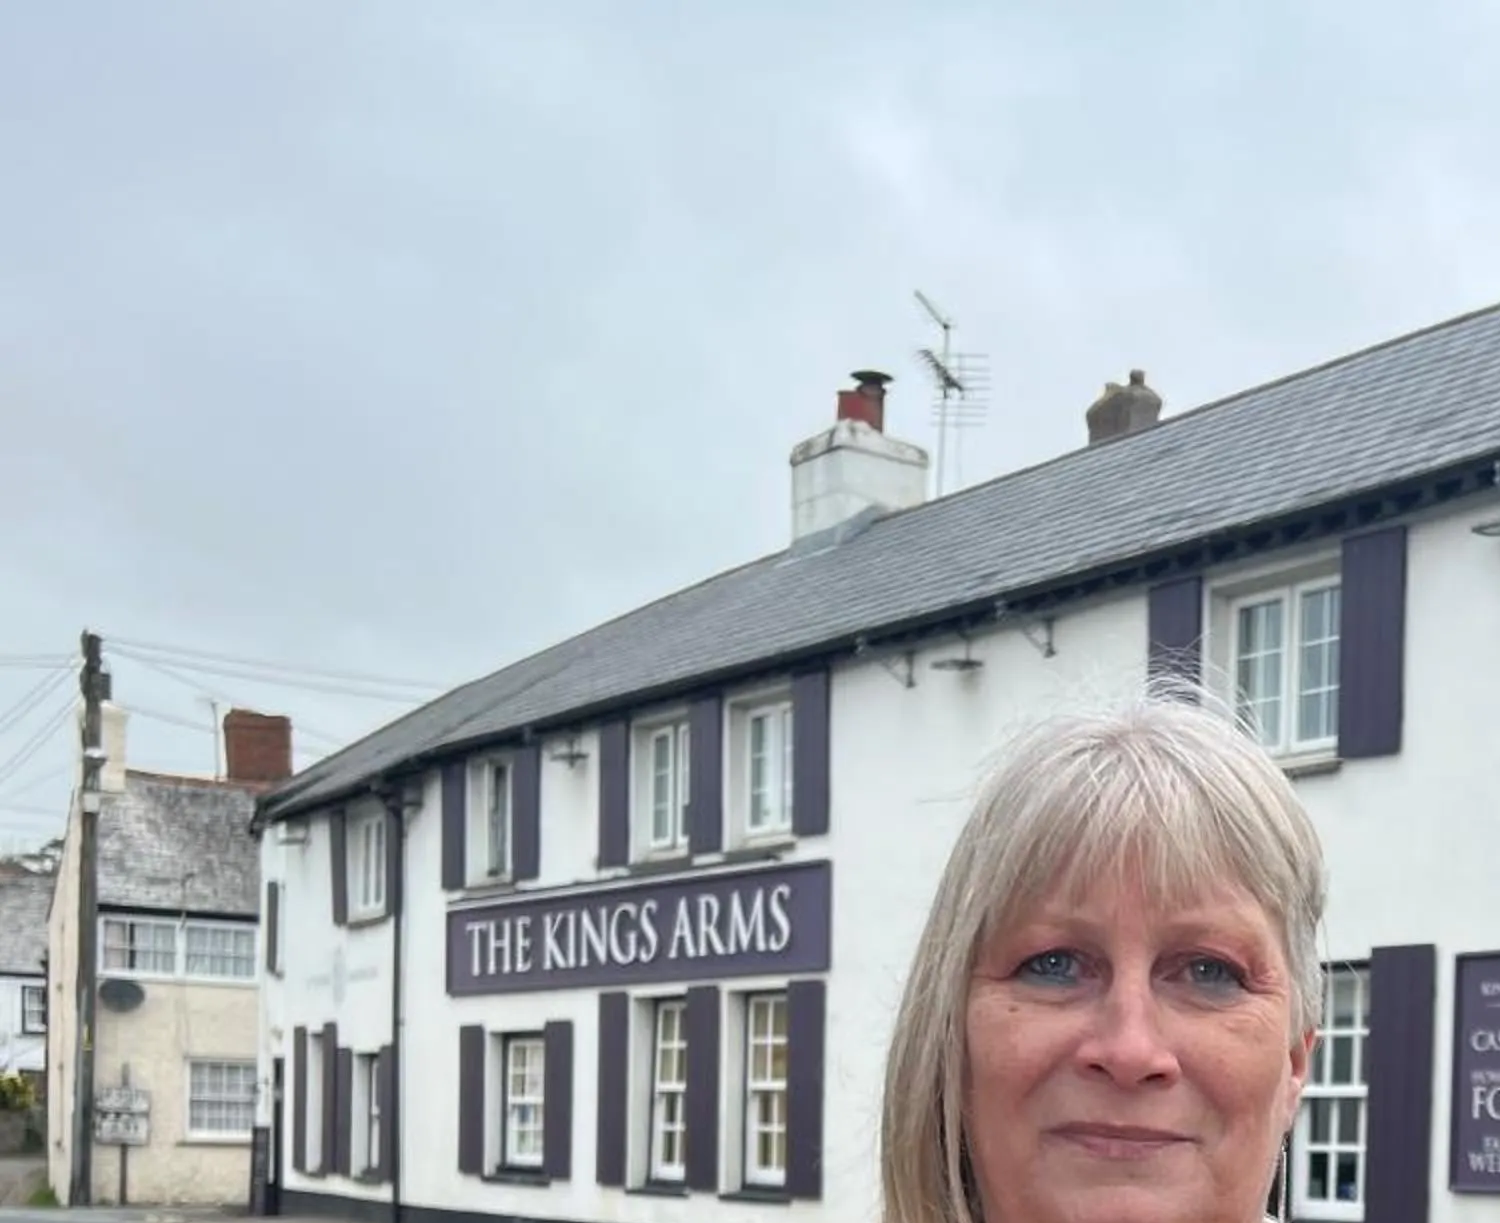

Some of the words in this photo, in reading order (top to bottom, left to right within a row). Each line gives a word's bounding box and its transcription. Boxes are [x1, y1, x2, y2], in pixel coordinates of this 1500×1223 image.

[465, 915, 531, 976] THE
[542, 900, 658, 971] KINGS
[668, 883, 792, 958] ARMS
